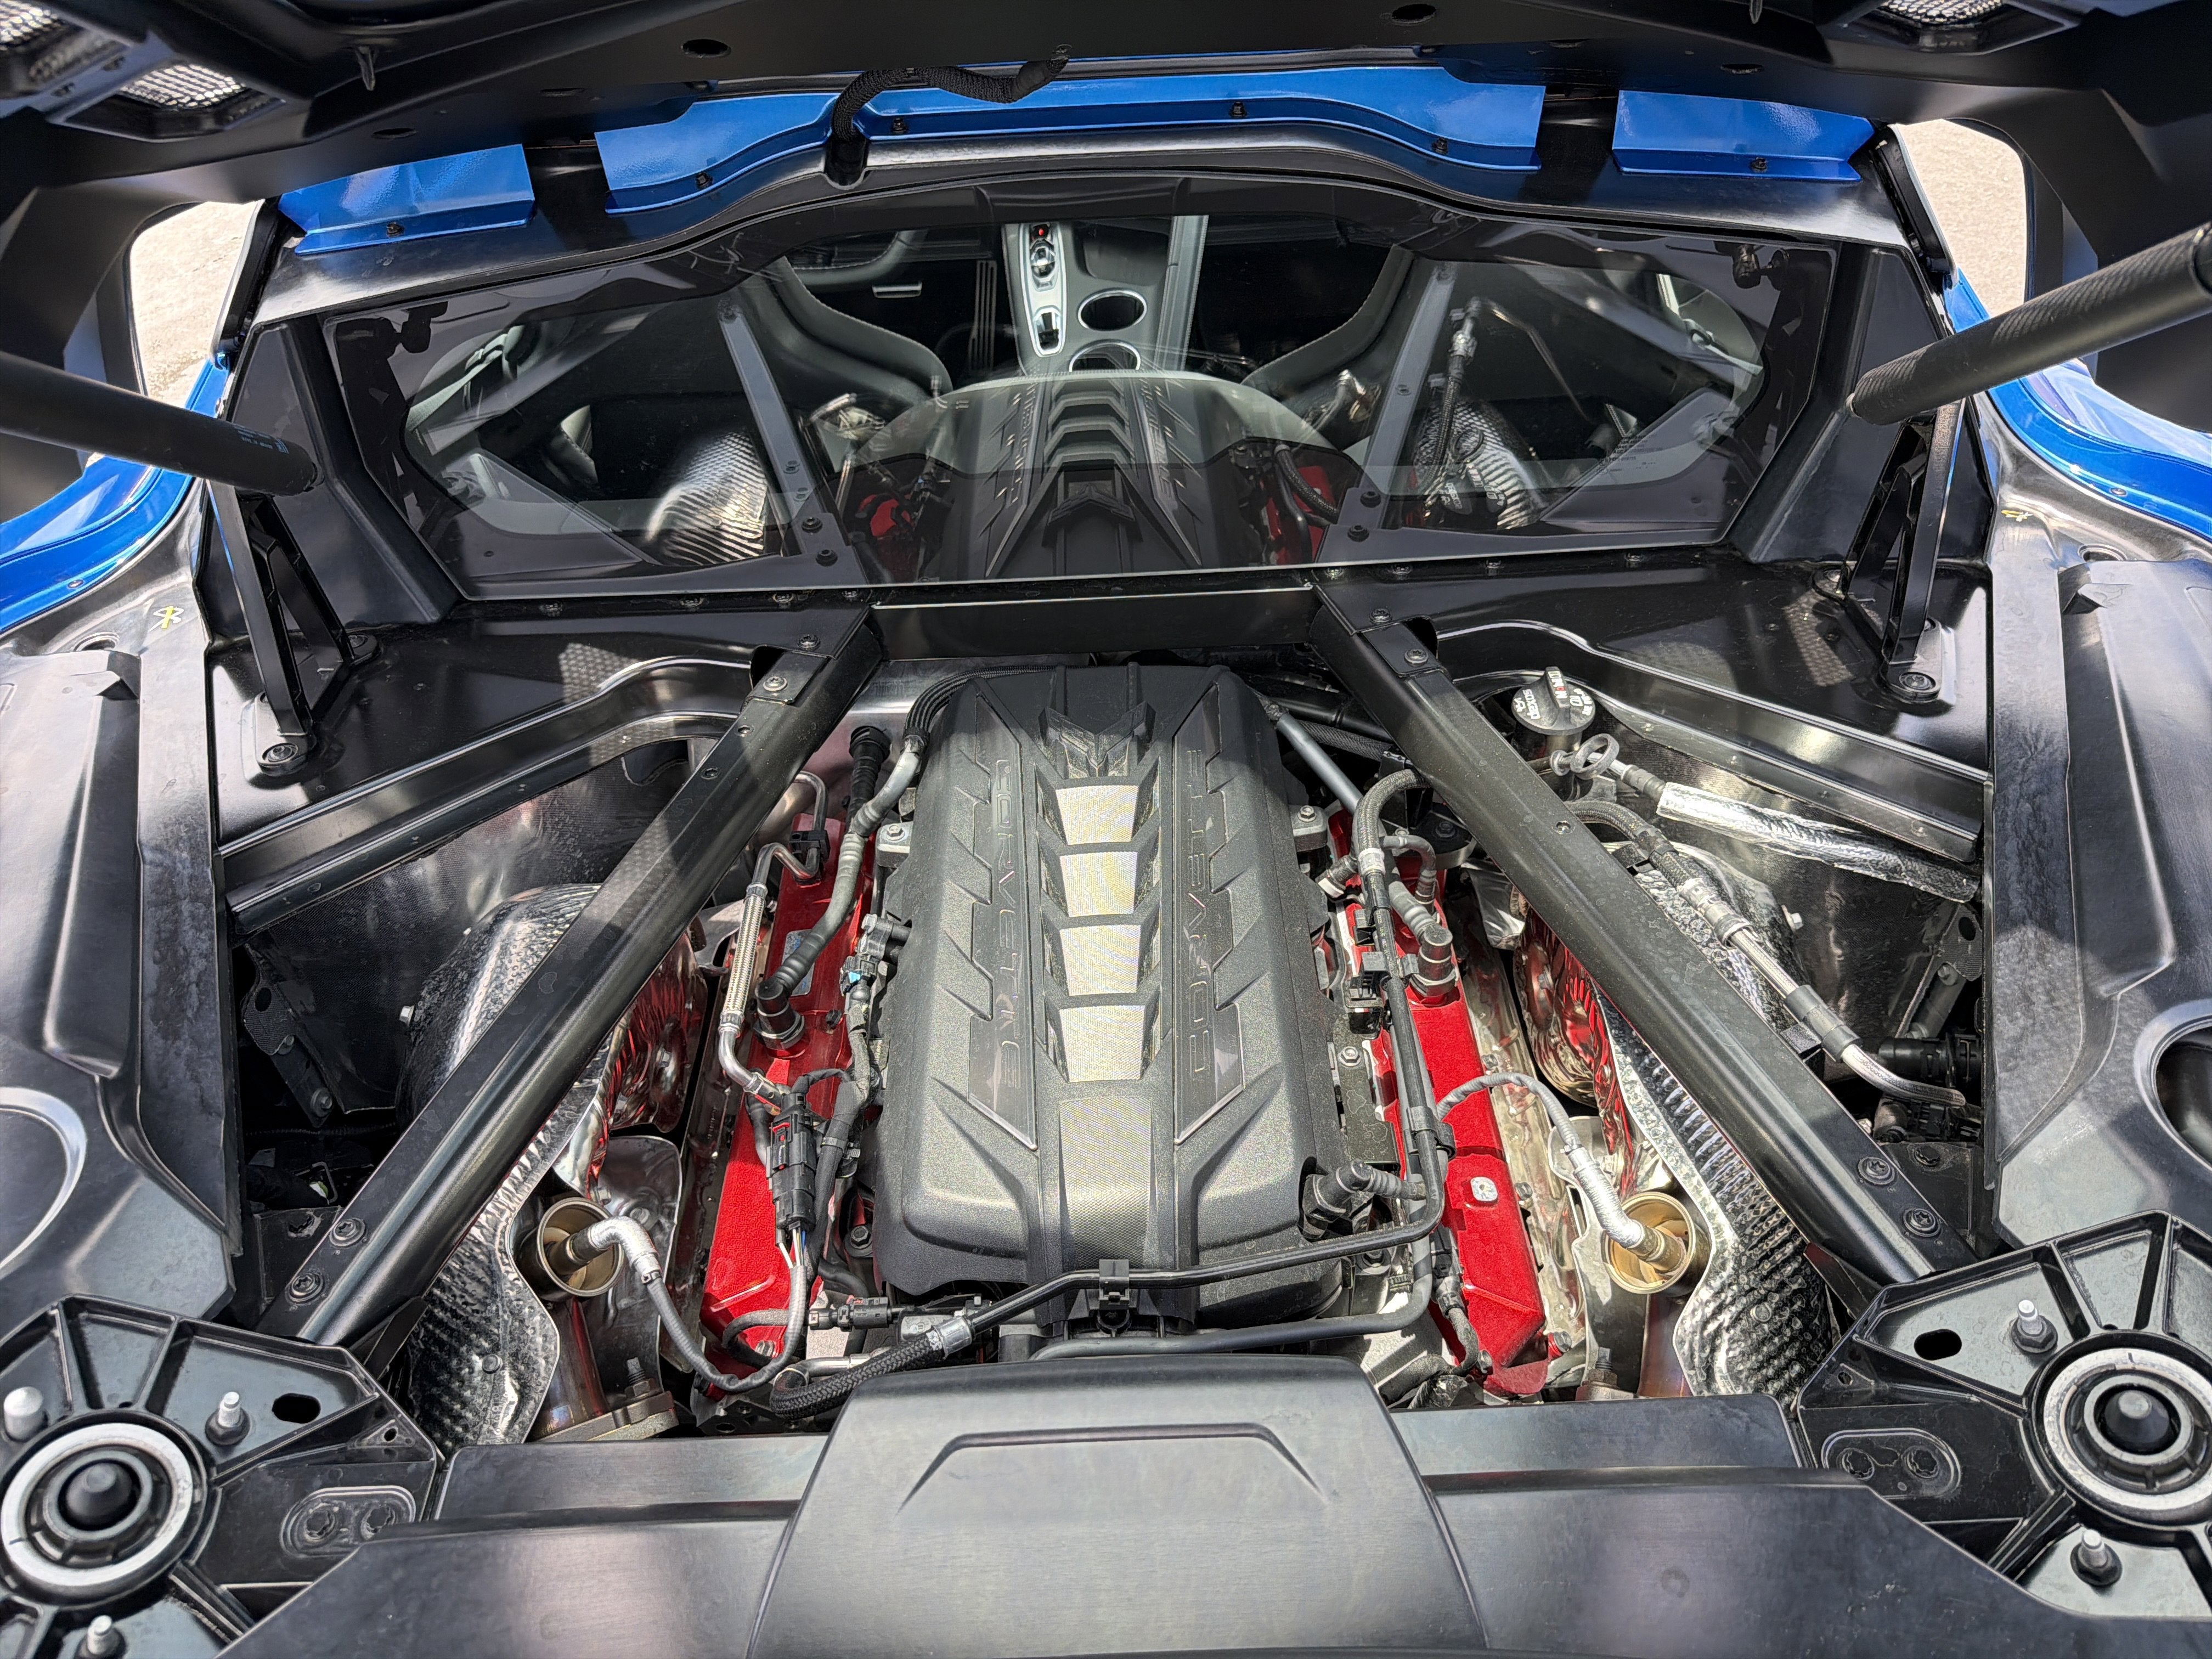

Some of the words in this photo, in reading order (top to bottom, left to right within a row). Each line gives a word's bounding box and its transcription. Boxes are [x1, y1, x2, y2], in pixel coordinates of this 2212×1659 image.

[1522, 689, 1541, 720] dexos
[1551, 678, 1568, 699] Mobil
[995, 759, 1021, 1089] CORVETTE
[1187, 749, 1211, 1076] CORVETTE
